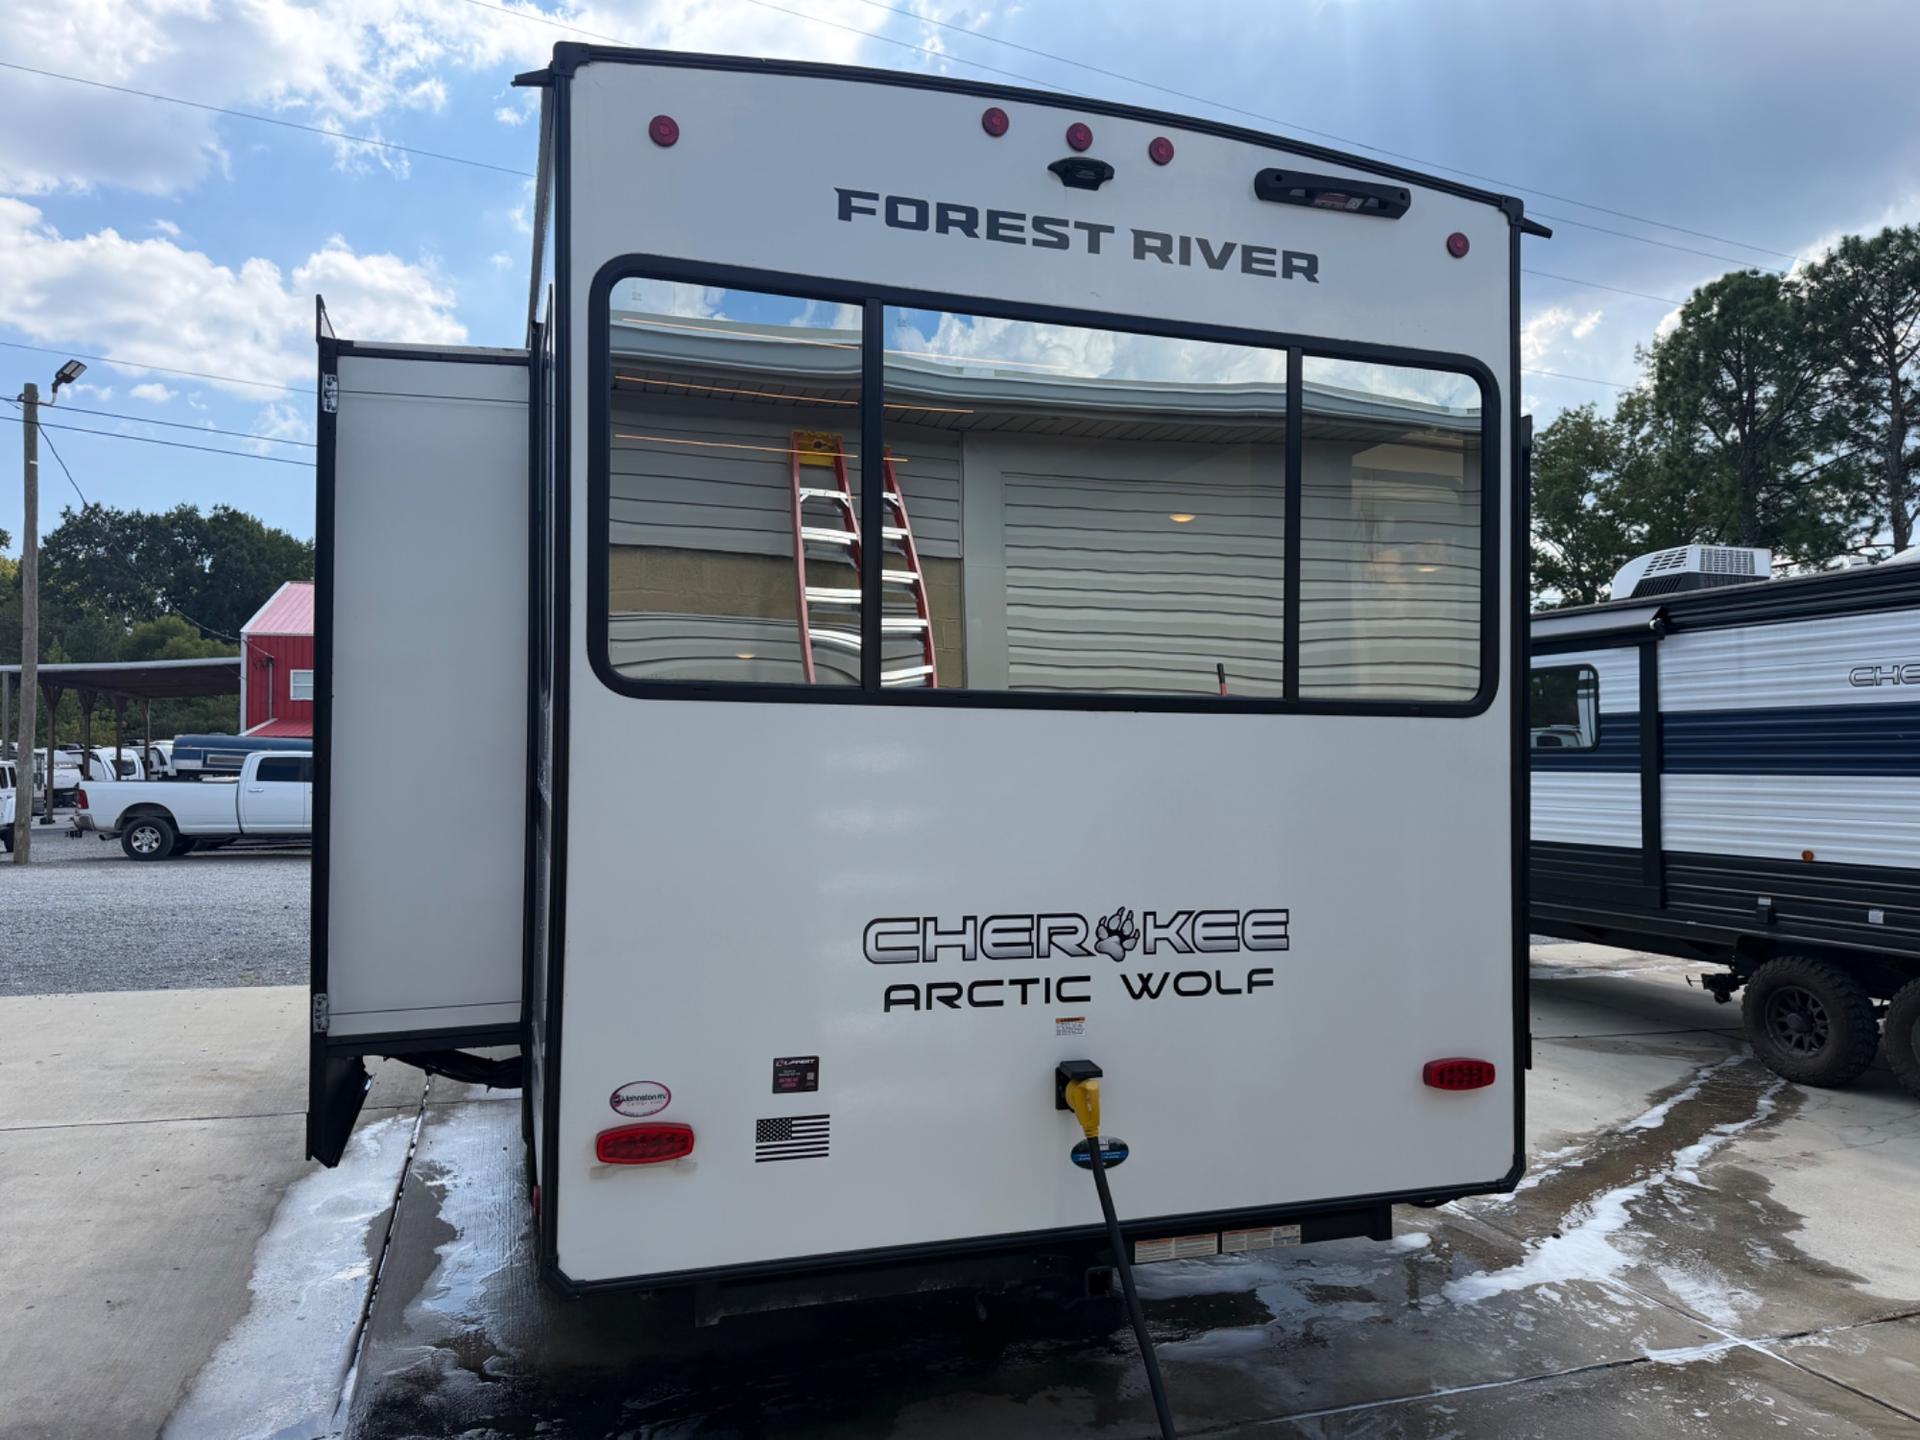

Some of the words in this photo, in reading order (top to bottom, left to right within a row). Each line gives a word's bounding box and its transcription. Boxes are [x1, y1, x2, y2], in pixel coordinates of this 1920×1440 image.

[833, 187, 1115, 254] FOREST
[1129, 228, 1320, 284] RIVER
[883, 975, 1092, 1013] ARCTIC
[1120, 967, 1275, 1001] WOLF
